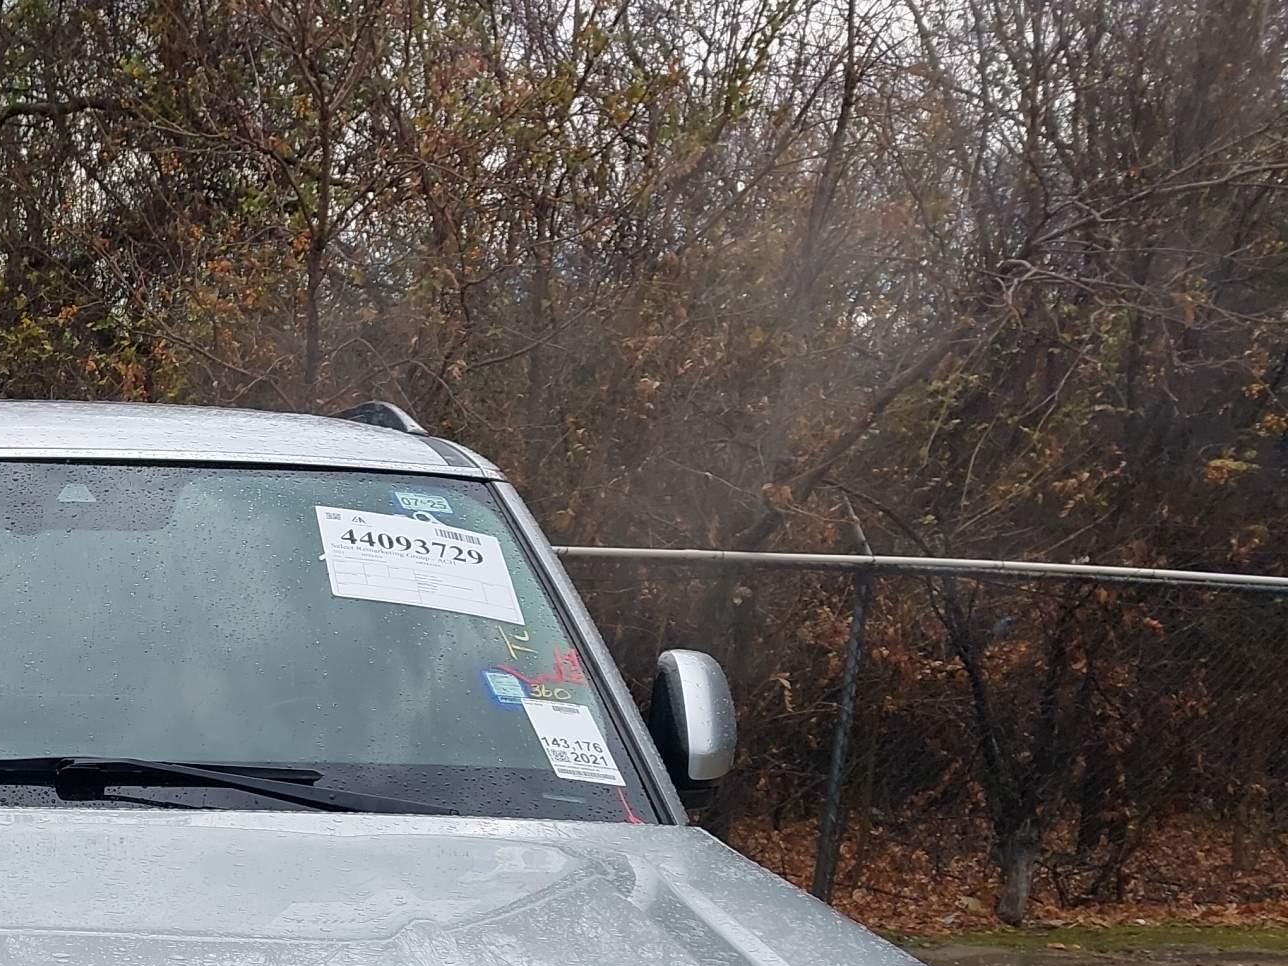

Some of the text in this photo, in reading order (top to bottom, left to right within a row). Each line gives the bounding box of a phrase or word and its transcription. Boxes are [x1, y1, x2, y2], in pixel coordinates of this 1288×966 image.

[400, 497, 447, 509] 07 25
[340, 528, 484, 565] 44093729
[529, 684, 571, 700] 360
[541, 736, 603, 753] 143,176
[571, 752, 608, 766] 2021
